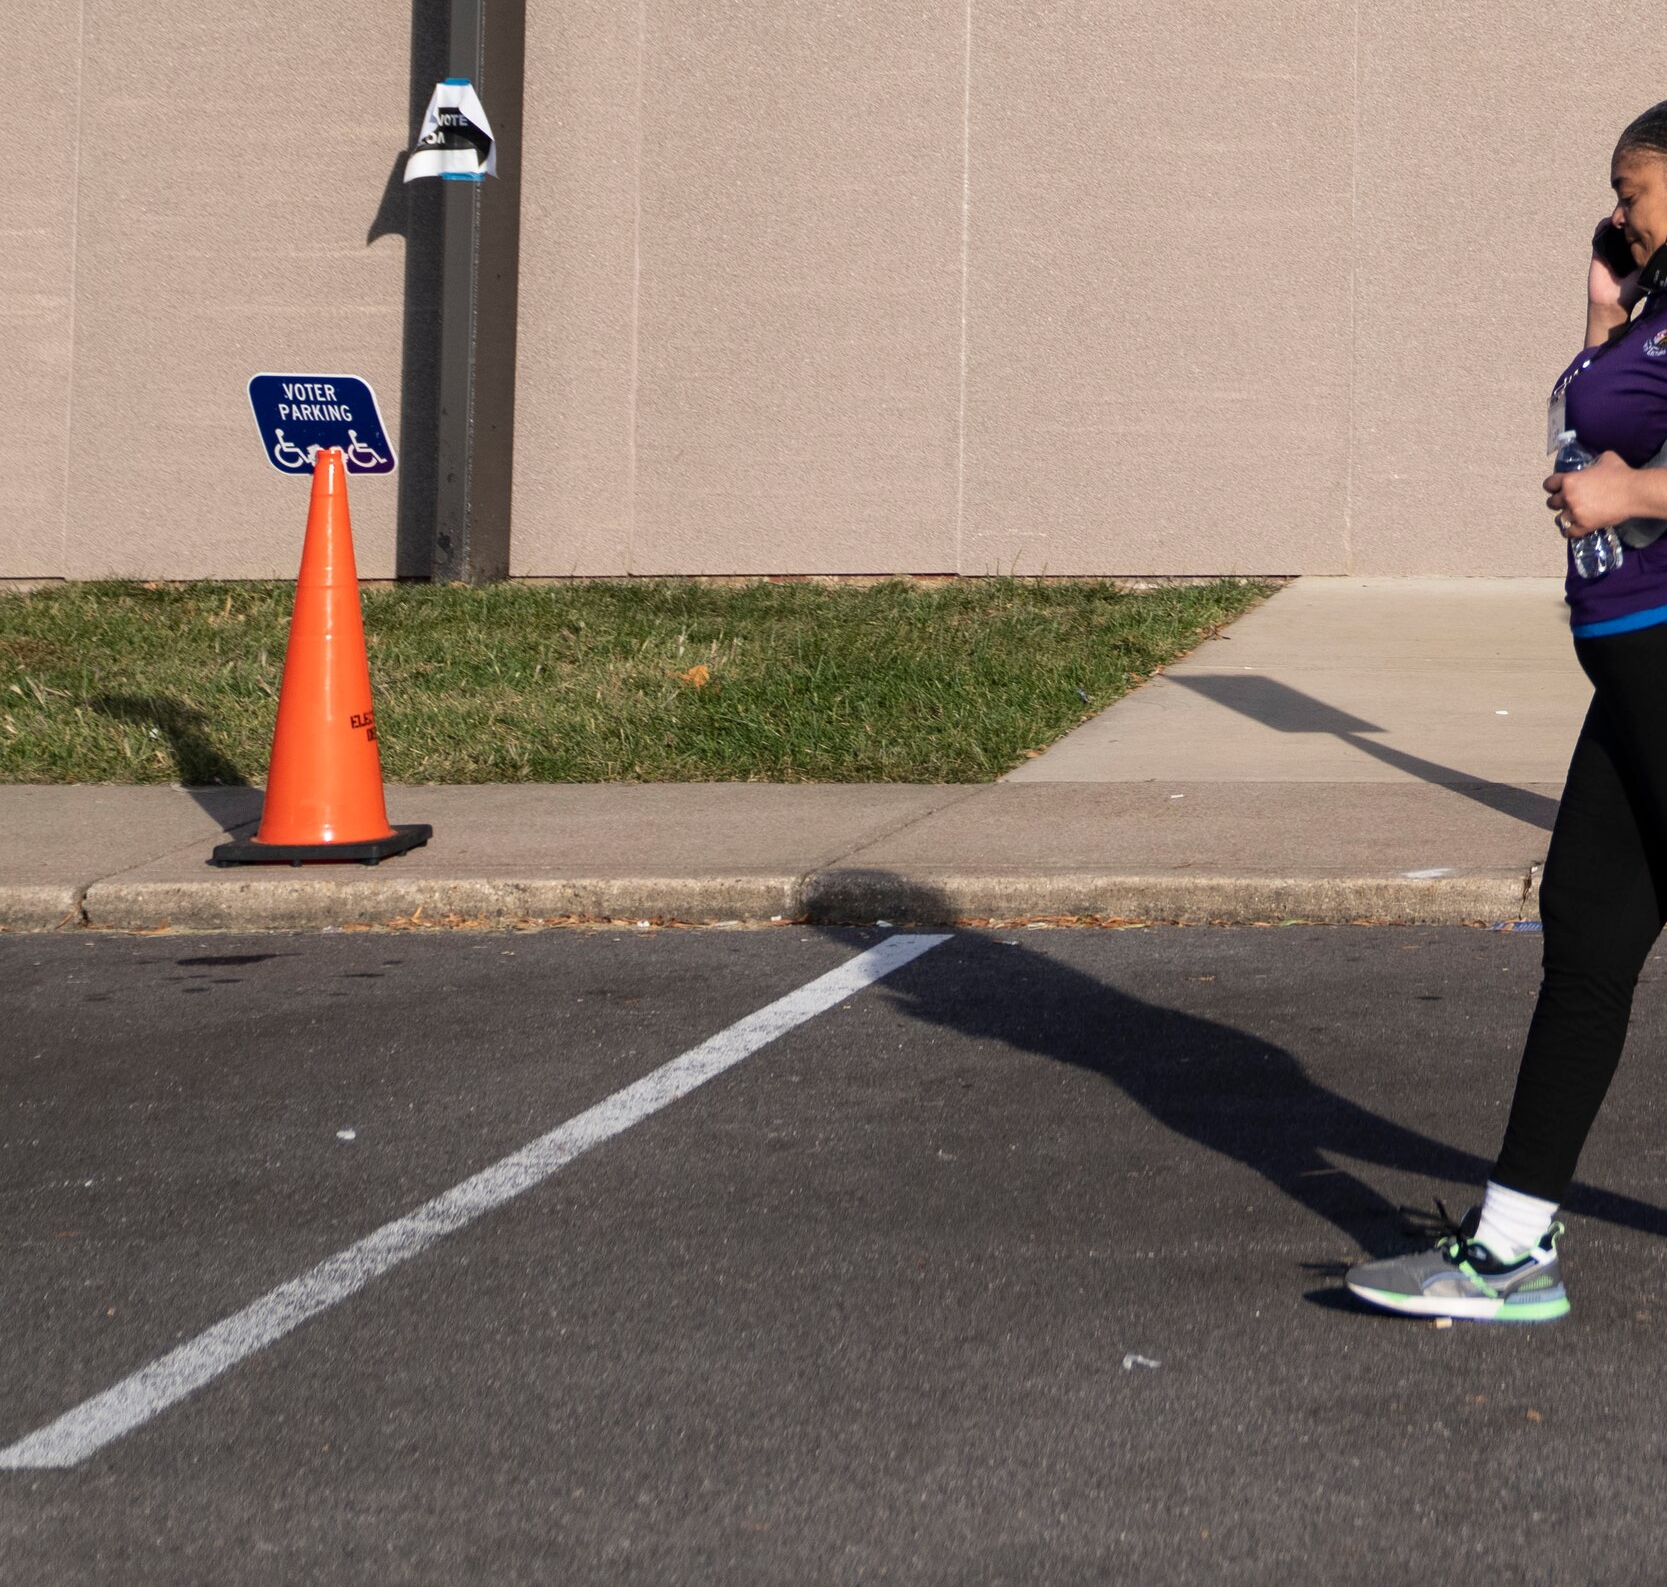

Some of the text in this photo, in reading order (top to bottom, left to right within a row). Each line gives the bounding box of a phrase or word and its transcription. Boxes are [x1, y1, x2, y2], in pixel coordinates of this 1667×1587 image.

[437, 114, 468, 126] VOTE
[425, 131, 446, 144] VO
[282, 383, 338, 402] VOTER
[278, 404, 353, 422] PARKING
